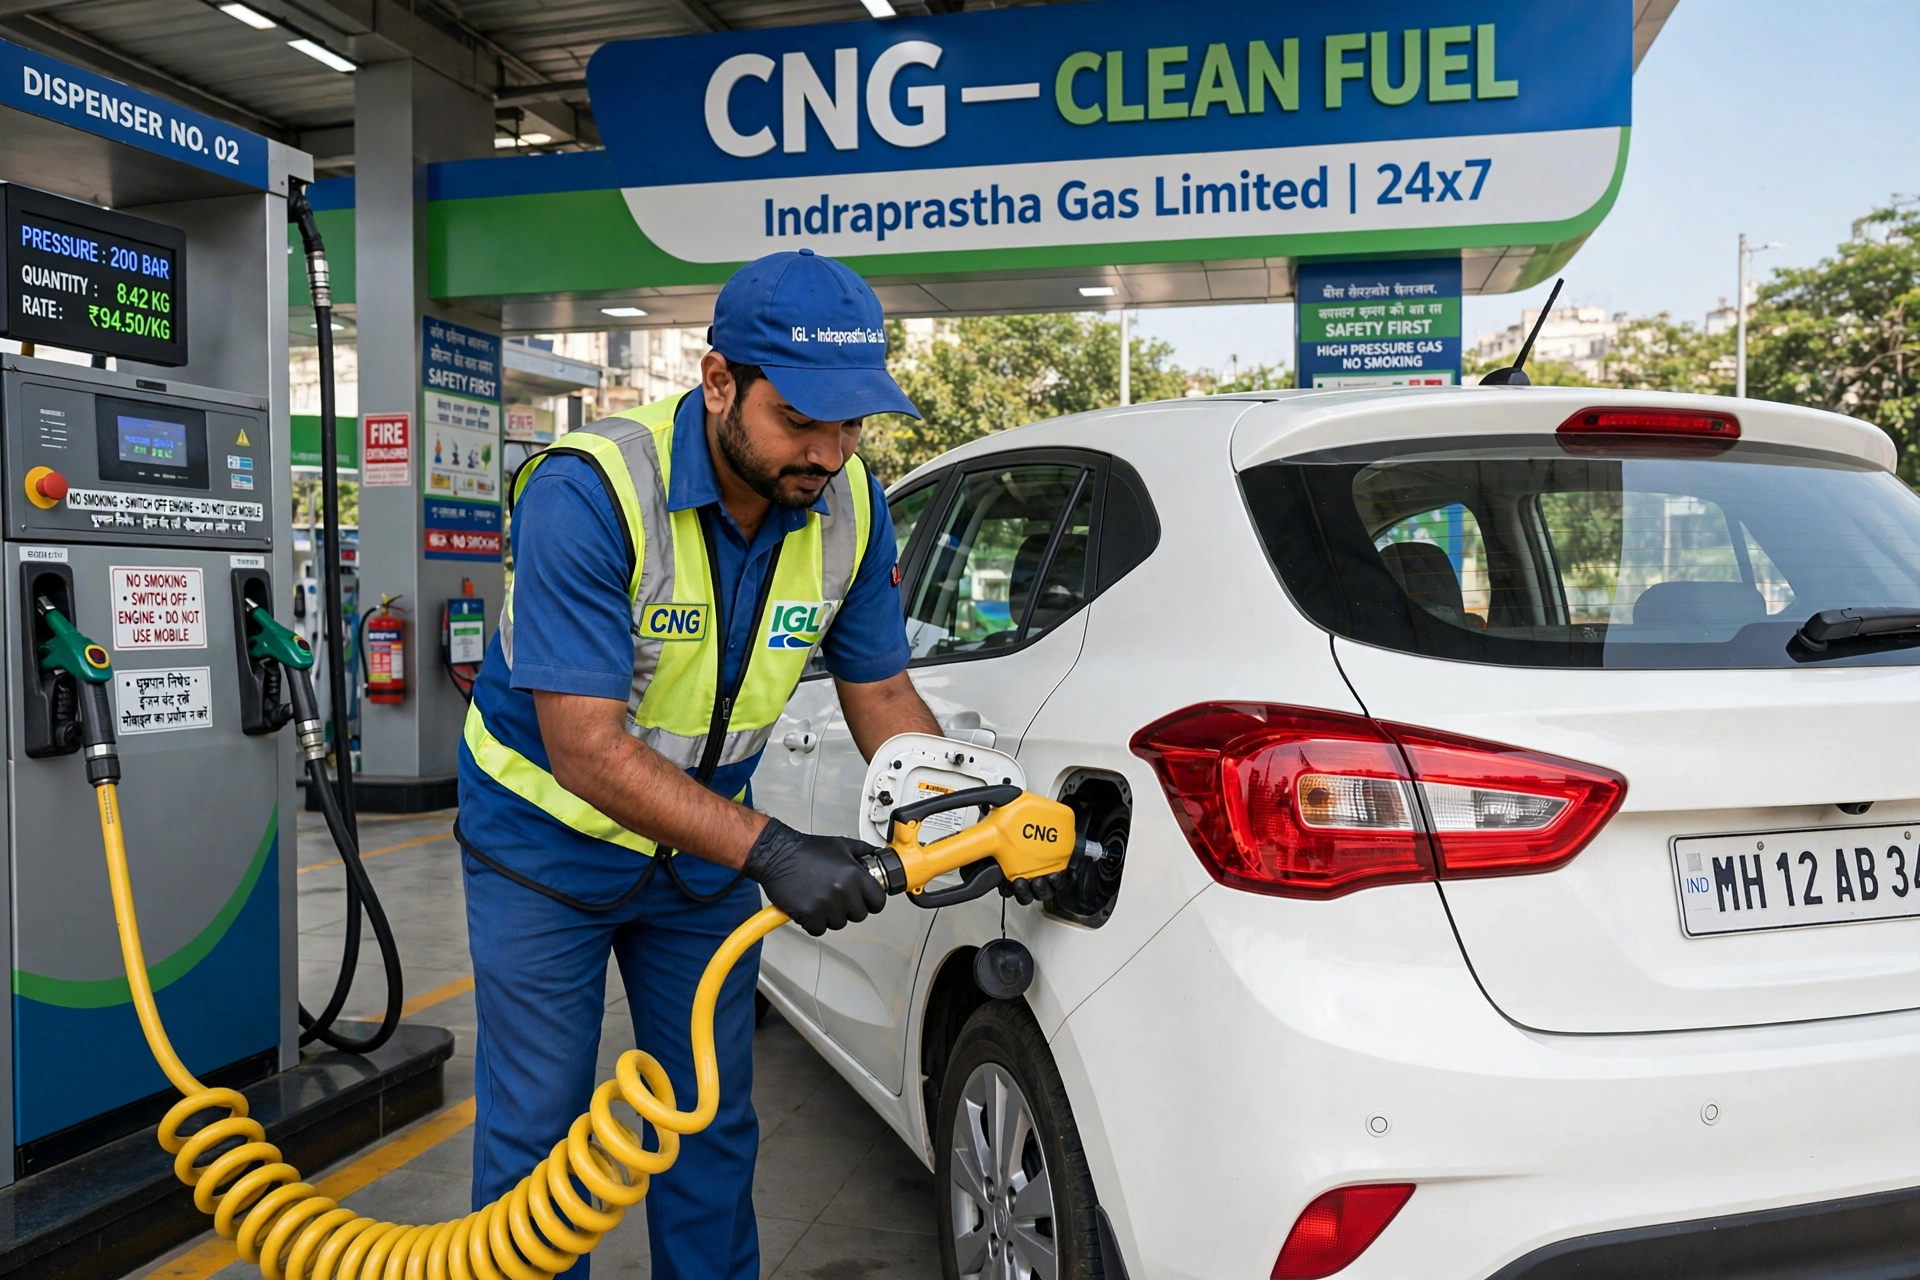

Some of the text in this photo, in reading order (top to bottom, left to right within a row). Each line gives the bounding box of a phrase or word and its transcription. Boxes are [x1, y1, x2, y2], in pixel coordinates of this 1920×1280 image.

[704, 40, 946, 157] CNG
[1055, 37, 1299, 125] CLEAN
[1325, 23, 1519, 108] FUEL
[23, 66, 240, 165] DISPENSER NO. 02
[764, 184, 1042, 241] Indraprastha
[1056, 180, 1140, 221] Gas
[1155, 165, 1328, 216] Limited
[1376, 158, 1492, 205] 24x7
[22, 225, 99, 263] PRESSURE
[110, 247, 138, 272] 200
[142, 254, 170, 280] BAR
[22, 264, 88, 296] QUANTITY
[117, 283, 170, 313] 8.42 KG
[88, 305, 170, 340] ₹94.50/KG
[1325, 319, 1432, 338] SAFETY FIRST
[792, 327, 809, 342] IGL
[1317, 341, 1443, 357] HIGH PRESSURE GAS
[1343, 355, 1423, 369] NO SMOKING
[428, 367, 496, 397] SAFETY FIRST
[371, 422, 404, 445] FIRE
[69, 492, 81, 505] NO
[83, 493, 118, 507] SMOKING
[126, 574, 187, 588] NO SMOKING
[131, 592, 187, 606] SWITCH OFF
[118, 610, 199, 625] ENGINE DO NOT
[650, 608, 700, 634] CNG
[771, 605, 820, 633] IGL
[133, 628, 189, 643] USE MOBILE
[1022, 824, 1058, 843] CNG
[1686, 877, 1710, 894] IND
[1711, 854, 1767, 912] MH
[1776, 850, 1823, 907] 12
[1835, 847, 1879, 903] AB
